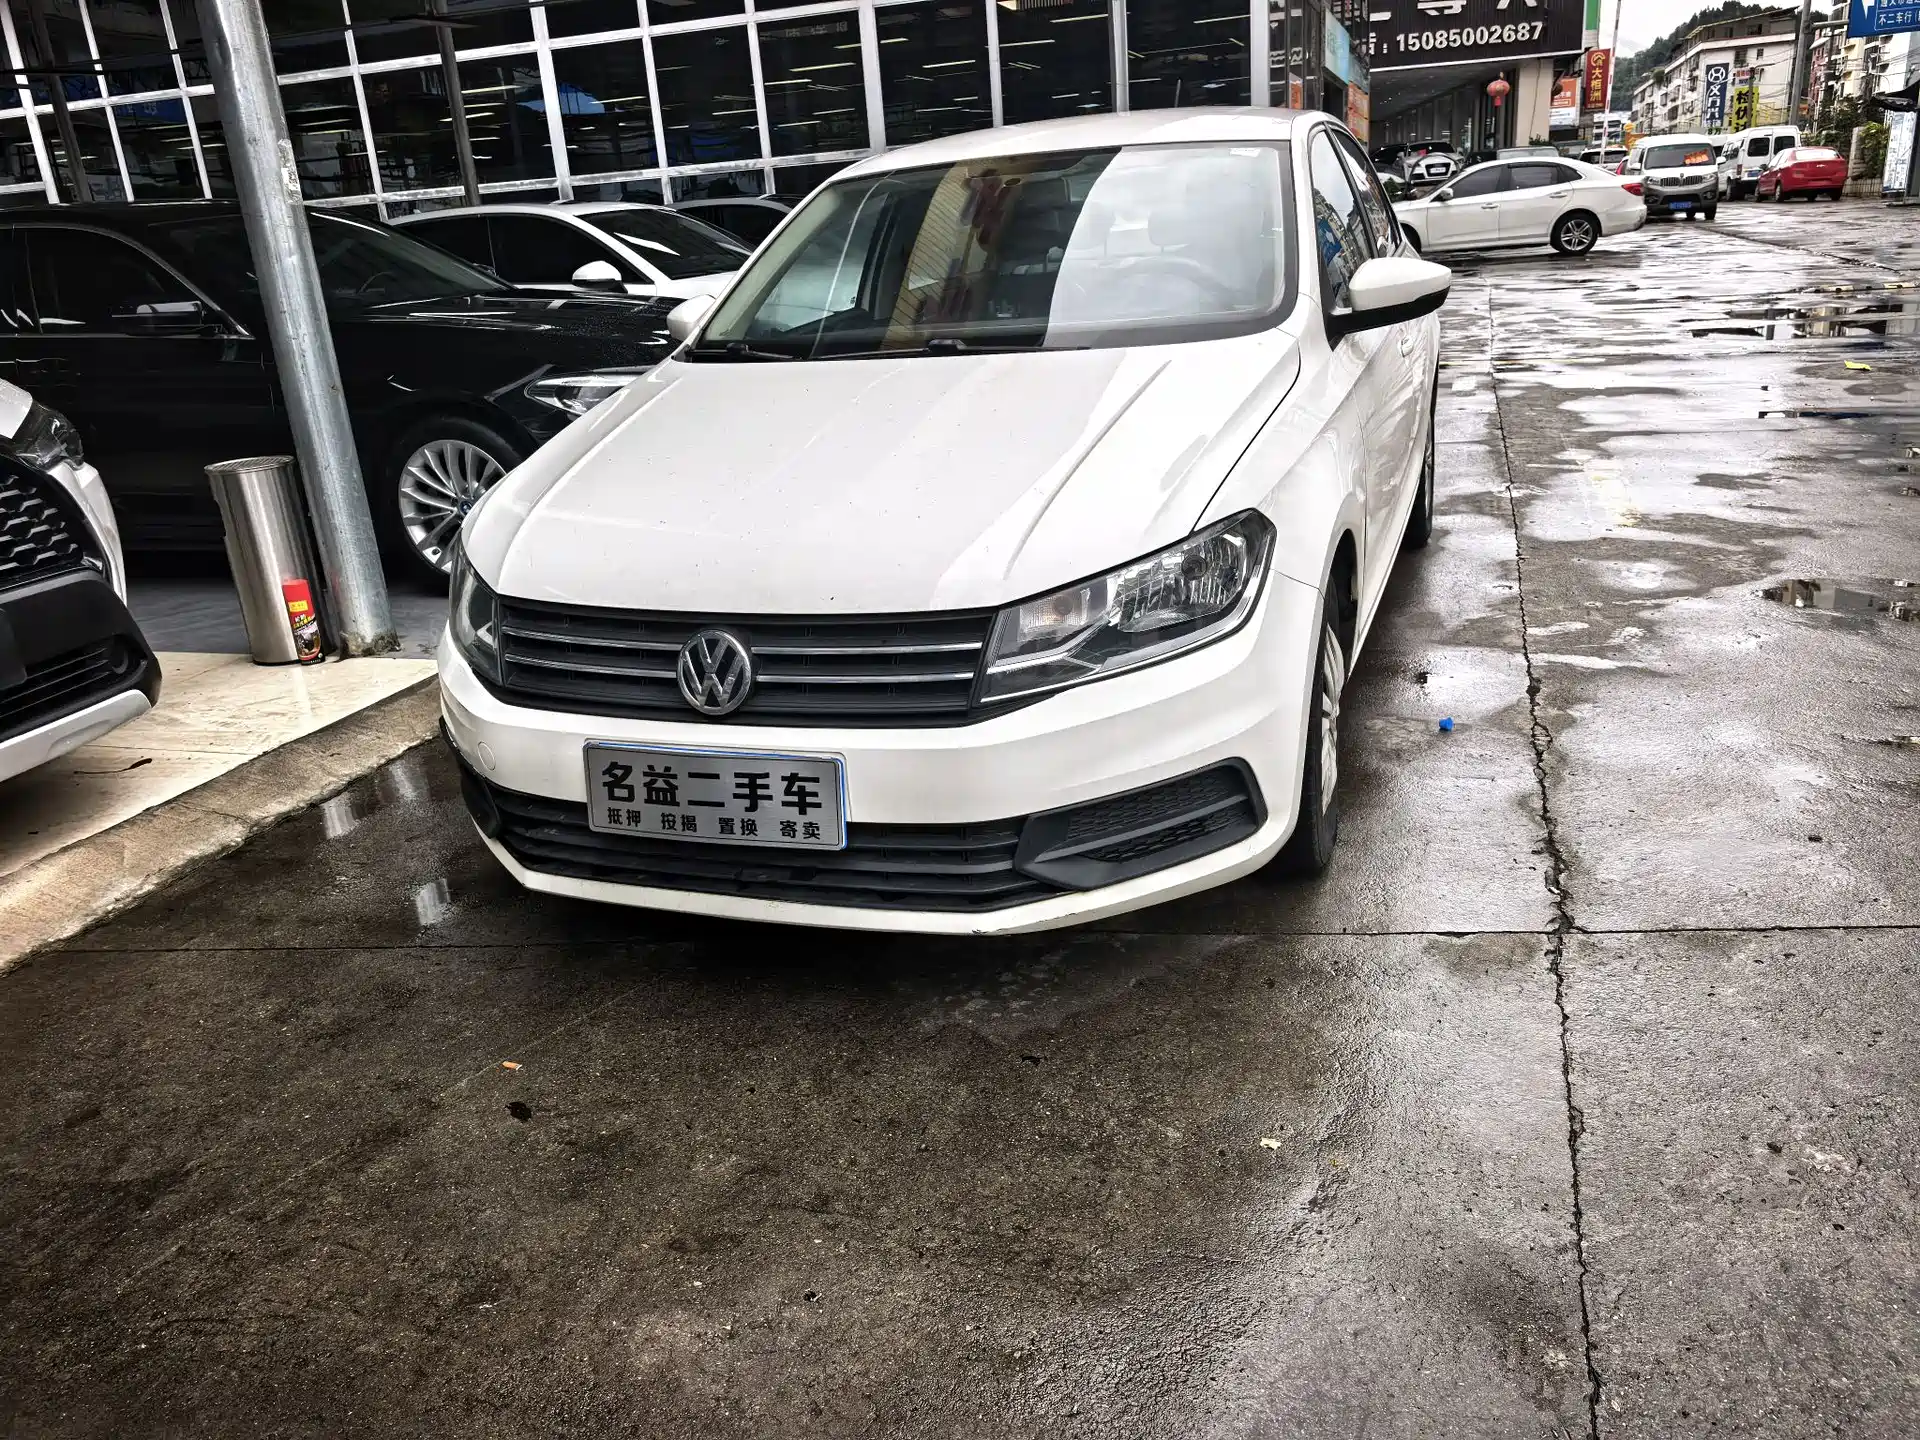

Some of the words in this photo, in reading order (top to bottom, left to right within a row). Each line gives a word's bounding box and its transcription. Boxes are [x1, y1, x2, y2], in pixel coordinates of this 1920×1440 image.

[602, 761, 822, 816] 名益二手车
[607, 806, 641, 828] 抵押
[660, 812, 698, 833] 按揭
[718, 817, 759, 837] 置换
[779, 820, 821, 840] 寄卖
